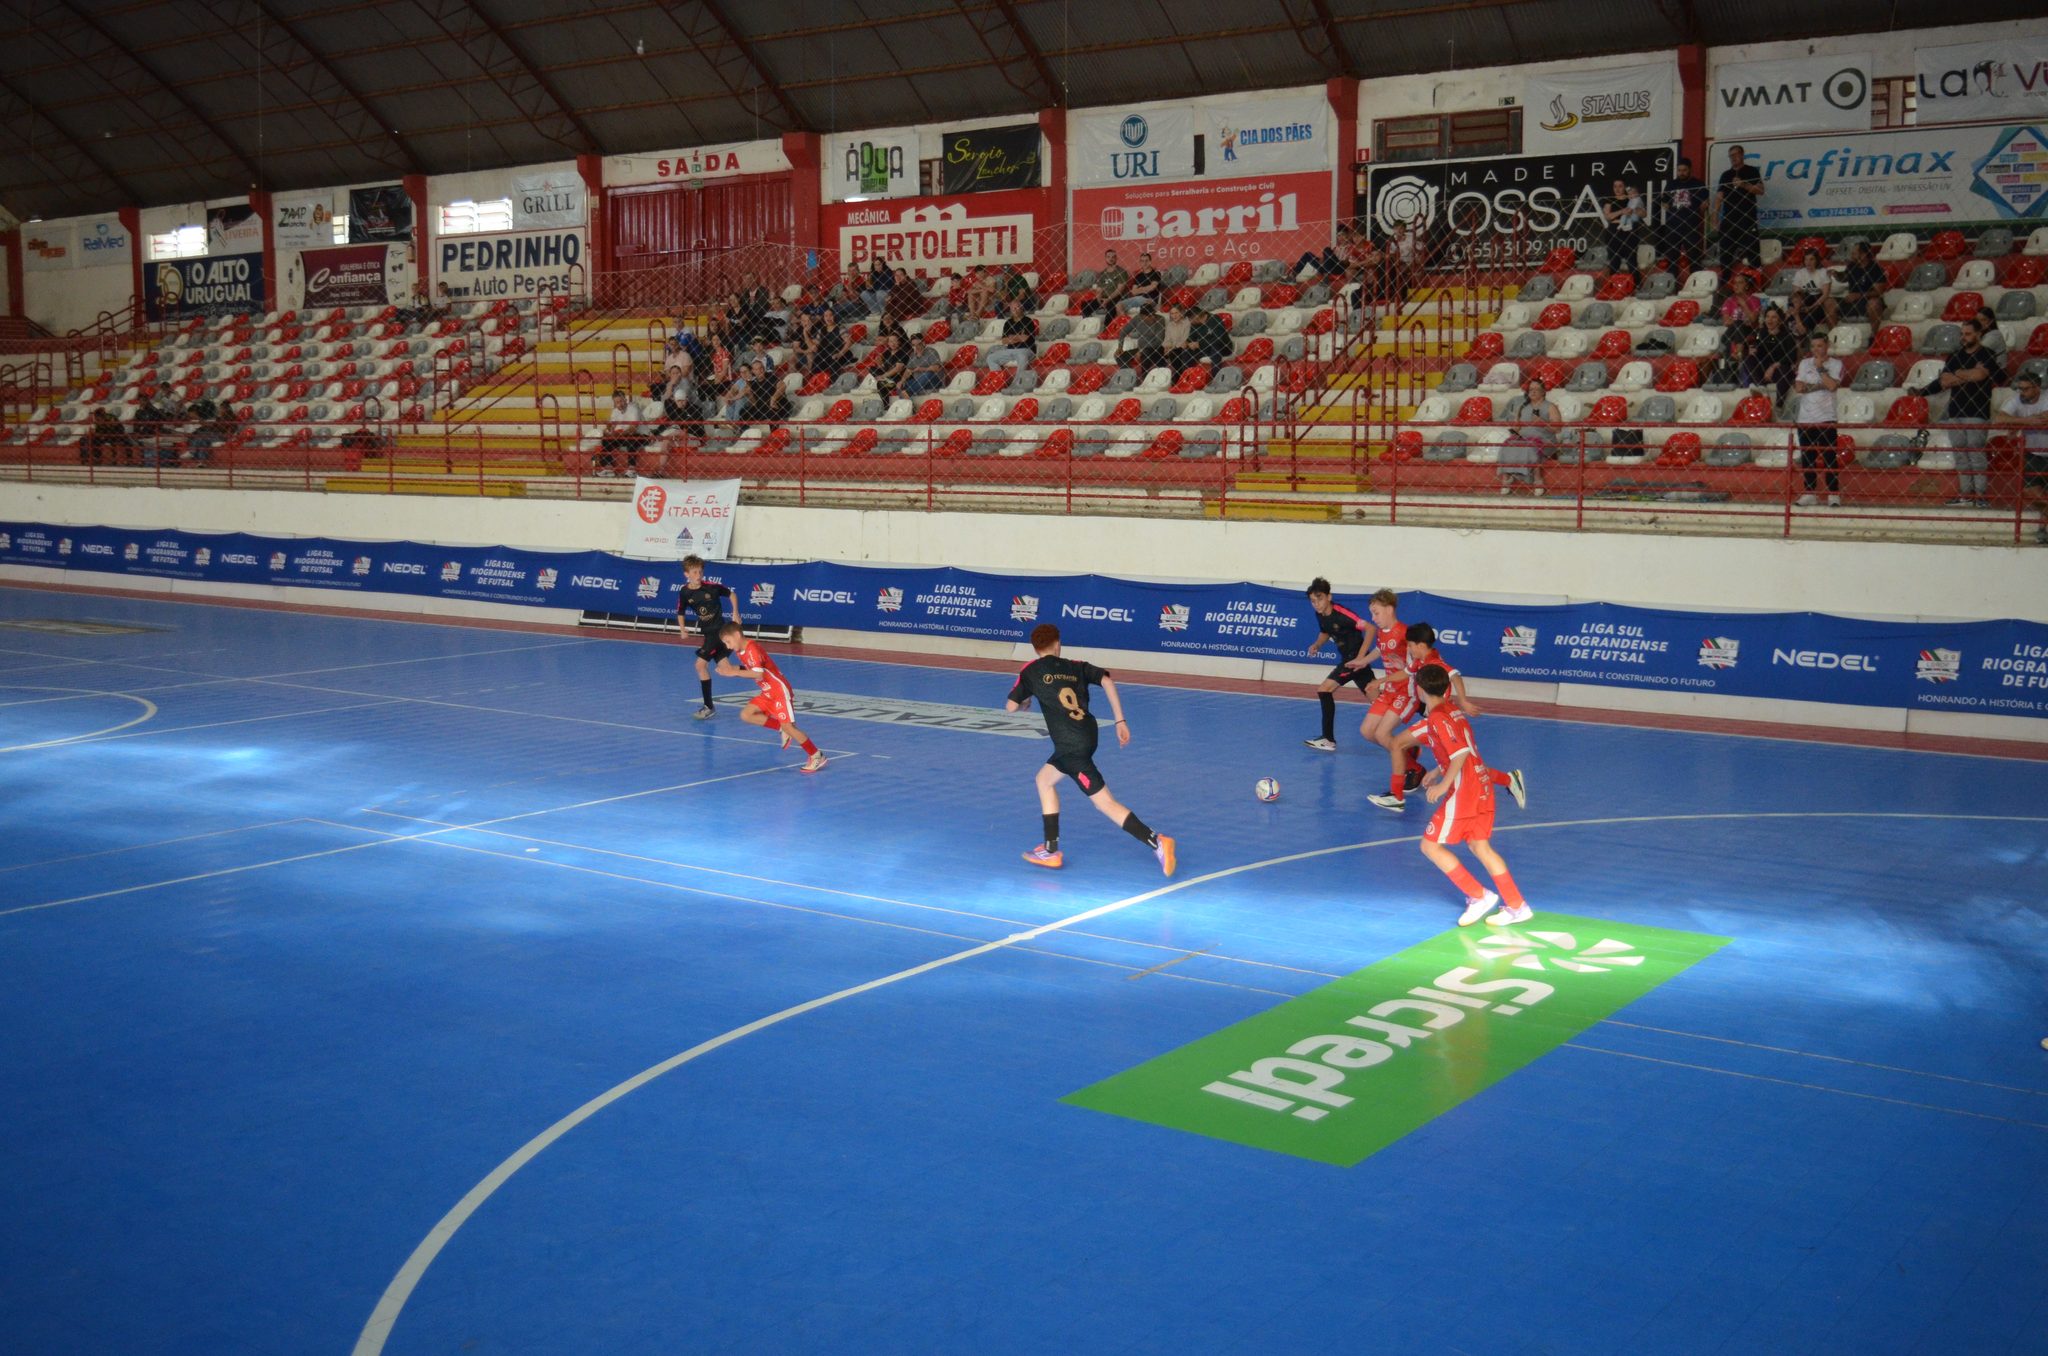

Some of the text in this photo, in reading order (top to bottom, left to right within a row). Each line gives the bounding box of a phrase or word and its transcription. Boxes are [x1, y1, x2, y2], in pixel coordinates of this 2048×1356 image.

[1720, 81, 1812, 108] VMAT
[1581, 91, 1650, 116] STALUS
[1240, 123, 1312, 145] CIA DOS PÃES
[1111, 151, 1160, 178] URI
[1451, 158, 1669, 185] MADEIRAS
[1744, 148, 1957, 196] rafimax
[1125, 191, 1153, 199] Soluções
[1171, 188, 1209, 196] Serralheria
[1216, 184, 1257, 193] Construção
[1259, 182, 1275, 190] Civil
[1825, 185, 1853, 195] OFFSET
[522, 193, 576, 215] GRILL
[1447, 183, 1667, 236] OSSAI
[847, 211, 891, 225] MECÂNICA
[1120, 192, 1299, 241] Barril
[850, 224, 1018, 263] BERTOLETTI
[1147, 239, 1260, 260] Ferro e Aço
[442, 233, 580, 272] PEDRINHO
[192, 263, 205, 285] O
[207, 258, 249, 284] ALTO
[308, 268, 381, 293] Confiança
[473, 277, 508, 296] Auto
[185, 283, 251, 304] URUGUAI
[81, 543, 114, 555] NEDEL
[221, 554, 258, 565] NEDEL
[485, 559, 515, 570] LIGA SUL
[311, 566, 333, 574] FUTSAL
[383, 563, 426, 575] NEDEL
[470, 567, 526, 580] RIOGRANDENSE
[477, 577, 514, 588] DE FUTSAL
[571, 575, 620, 591] NEDEL
[707, 576, 722, 585] SUL
[793, 588, 855, 604] NEDEL
[934, 584, 976, 596] LIGA SUL
[916, 595, 992, 608] RIOGRANDENSE
[1226, 601, 1277, 614] LIGA SUL
[927, 606, 977, 618] DE FUTSAL
[1061, 603, 1133, 623] NEDEL
[1204, 612, 1298, 628] RIOGRANDENSE
[878, 620, 913, 629] HONRANDO
[918, 622, 945, 631] HISTÓRIA
[950, 625, 993, 635] CONSTRUINDO
[999, 629, 1023, 637] FUTURO
[1218, 625, 1278, 638] DE FUTSAL
[1581, 622, 1644, 638] LIGA SUL
[1161, 640, 1201, 650] HONRANDO
[1208, 641, 1239, 652] HISTÓRIA
[1246, 646, 1298, 657] CONSTRUINDO
[1554, 635, 1668, 652] RIOGRANDENSE
[1570, 648, 1646, 664] DE FUTSAL
[1772, 648, 1877, 672] NEDEL
[1501, 666, 1549, 676] HONRANDO
[1559, 667, 1597, 679] HISTÓRIA
[1605, 672, 1668, 685] CONSTRUINDO
[1670, 677, 1678, 685] O
[1680, 678, 1715, 687] FUTURO
[2002, 673, 2024, 687] DE
[1058, 686, 1086, 721] 9
[1918, 694, 1977, 706] HONRANDO
[1989, 697, 2034, 710] HISTÓRIA
[2036, 702, 2042, 710] E
[1201, 966, 1555, 1121] Sicredi
